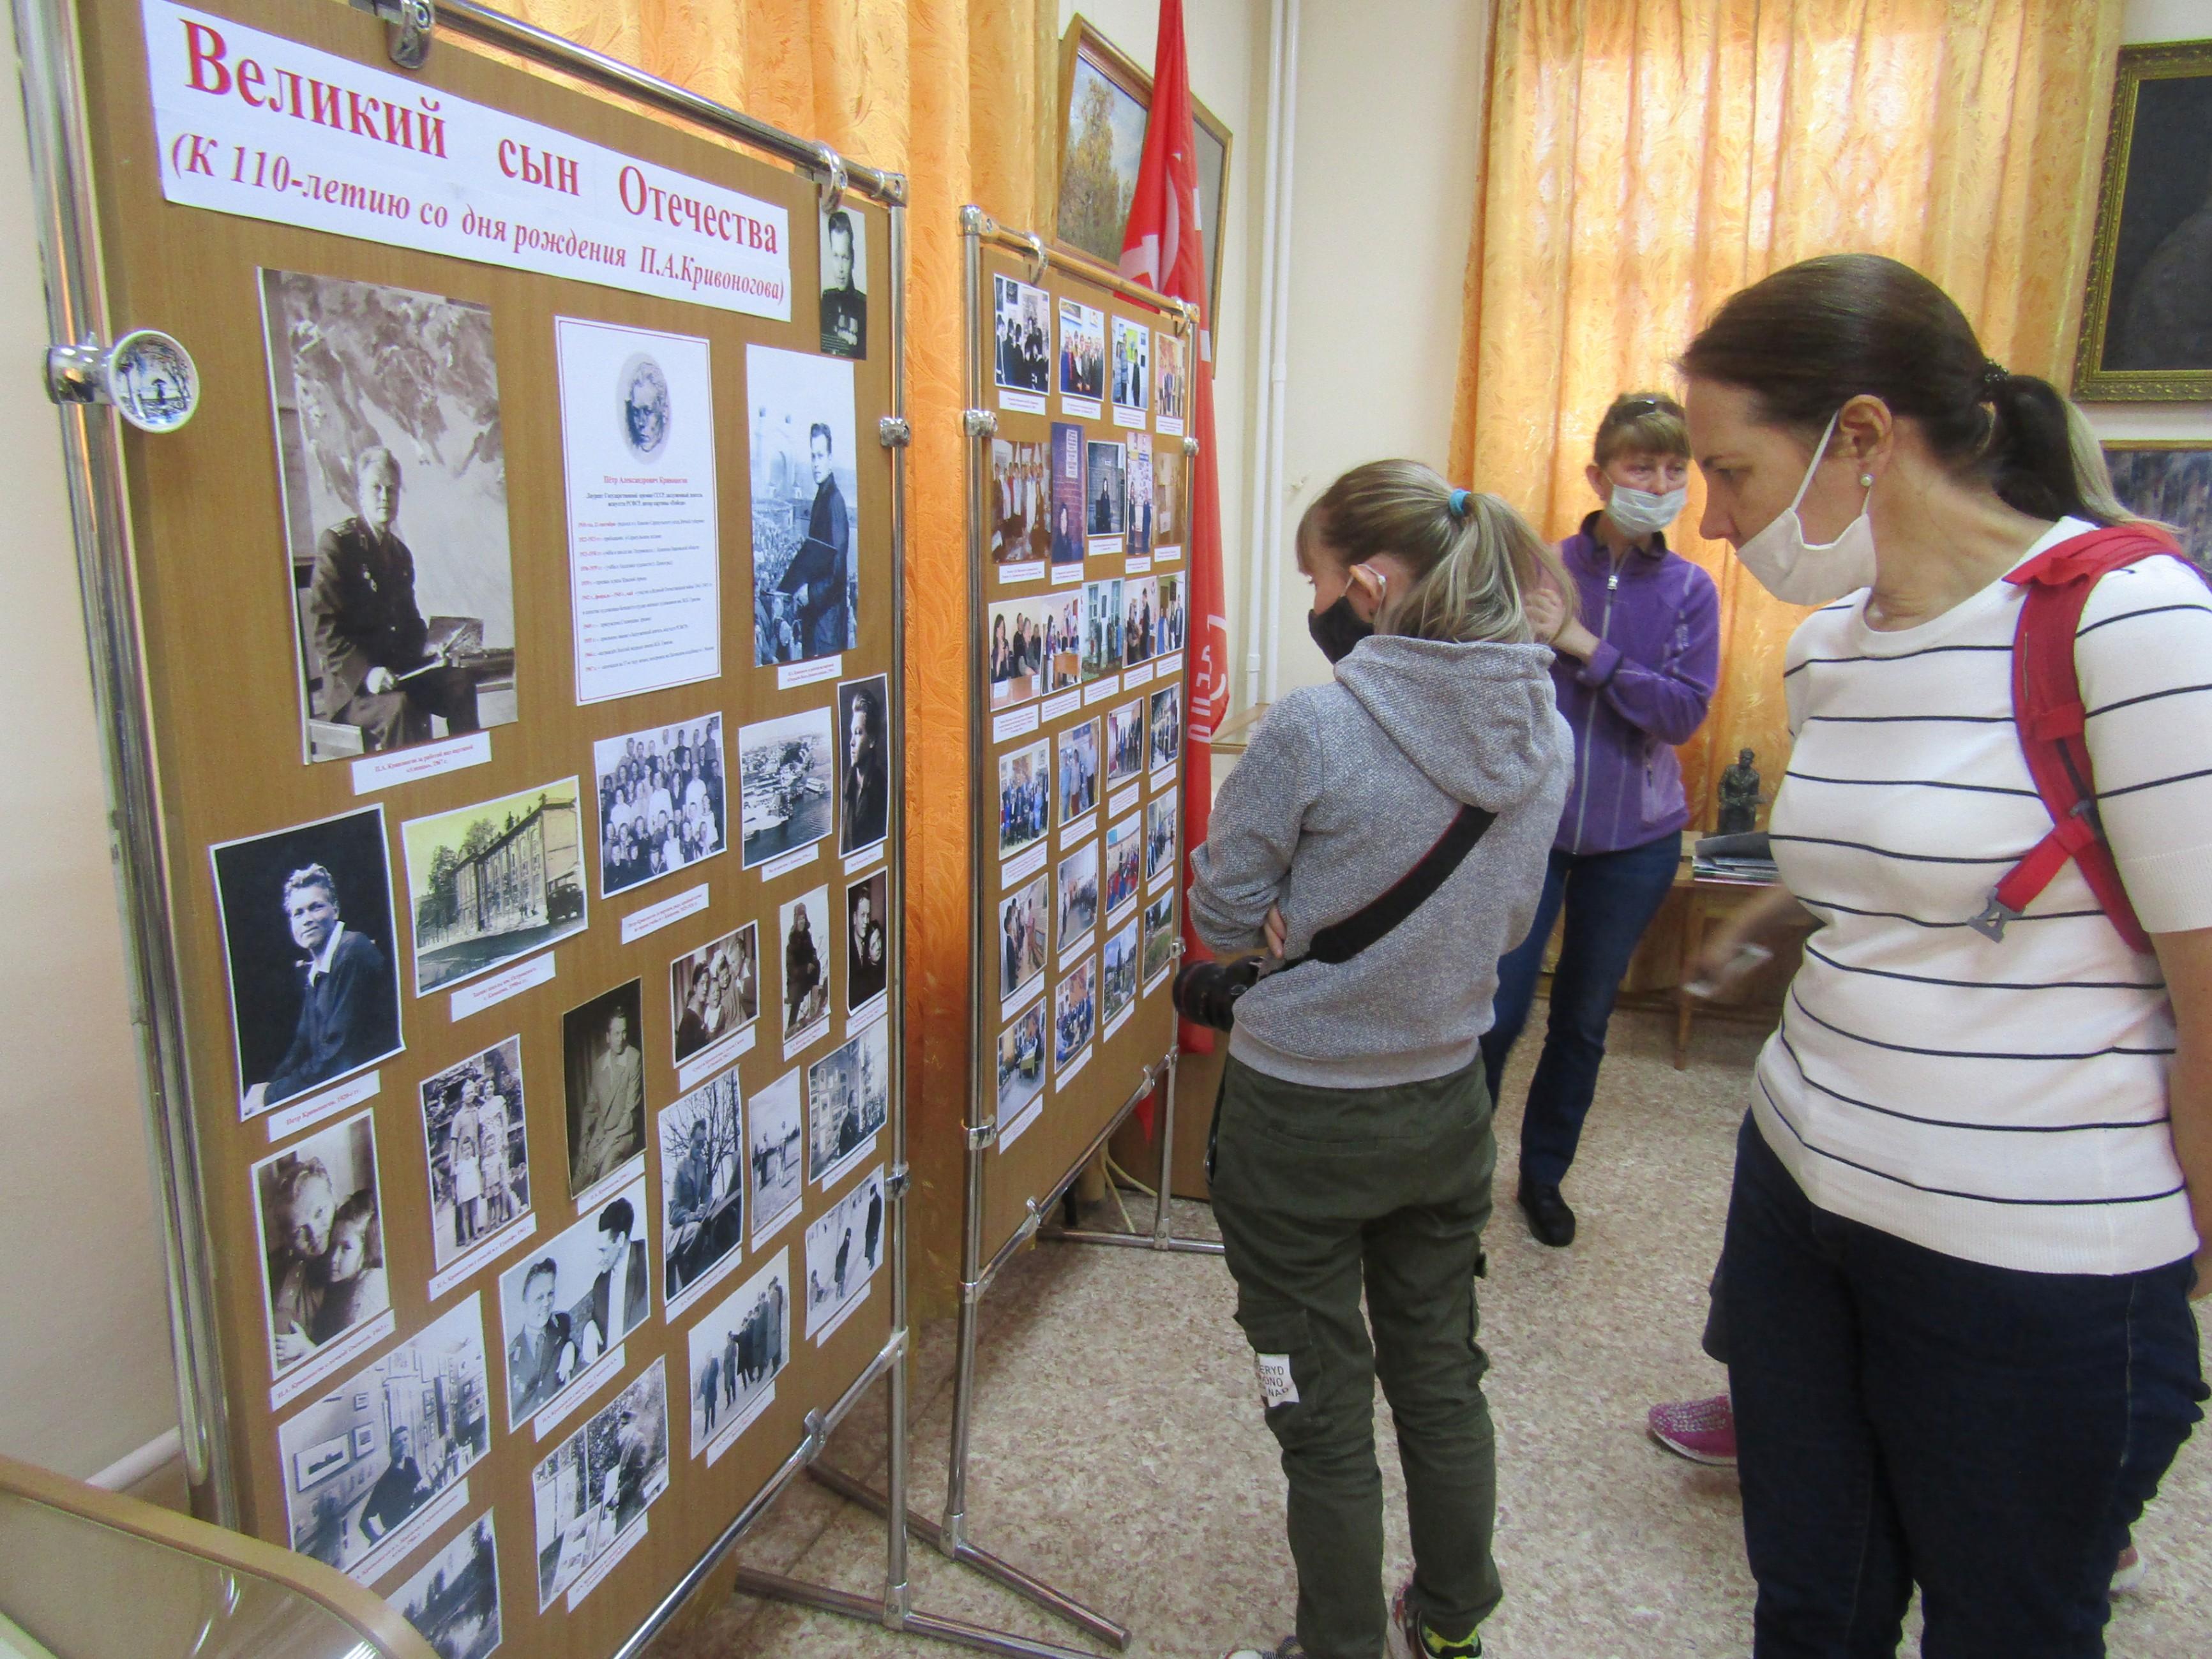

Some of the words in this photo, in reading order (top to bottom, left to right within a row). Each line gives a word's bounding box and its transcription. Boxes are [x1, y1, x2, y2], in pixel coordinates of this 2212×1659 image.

[171, 133, 218, 178] (К
[230, 146, 411, 221] 110-летию
[419, 202, 449, 229] со
[462, 204, 508, 243] дня
[513, 223, 628, 269] рождения
[179, 19, 448, 160] Великий
[498, 137, 581, 197] сын
[618, 164, 779, 255] Отечества
